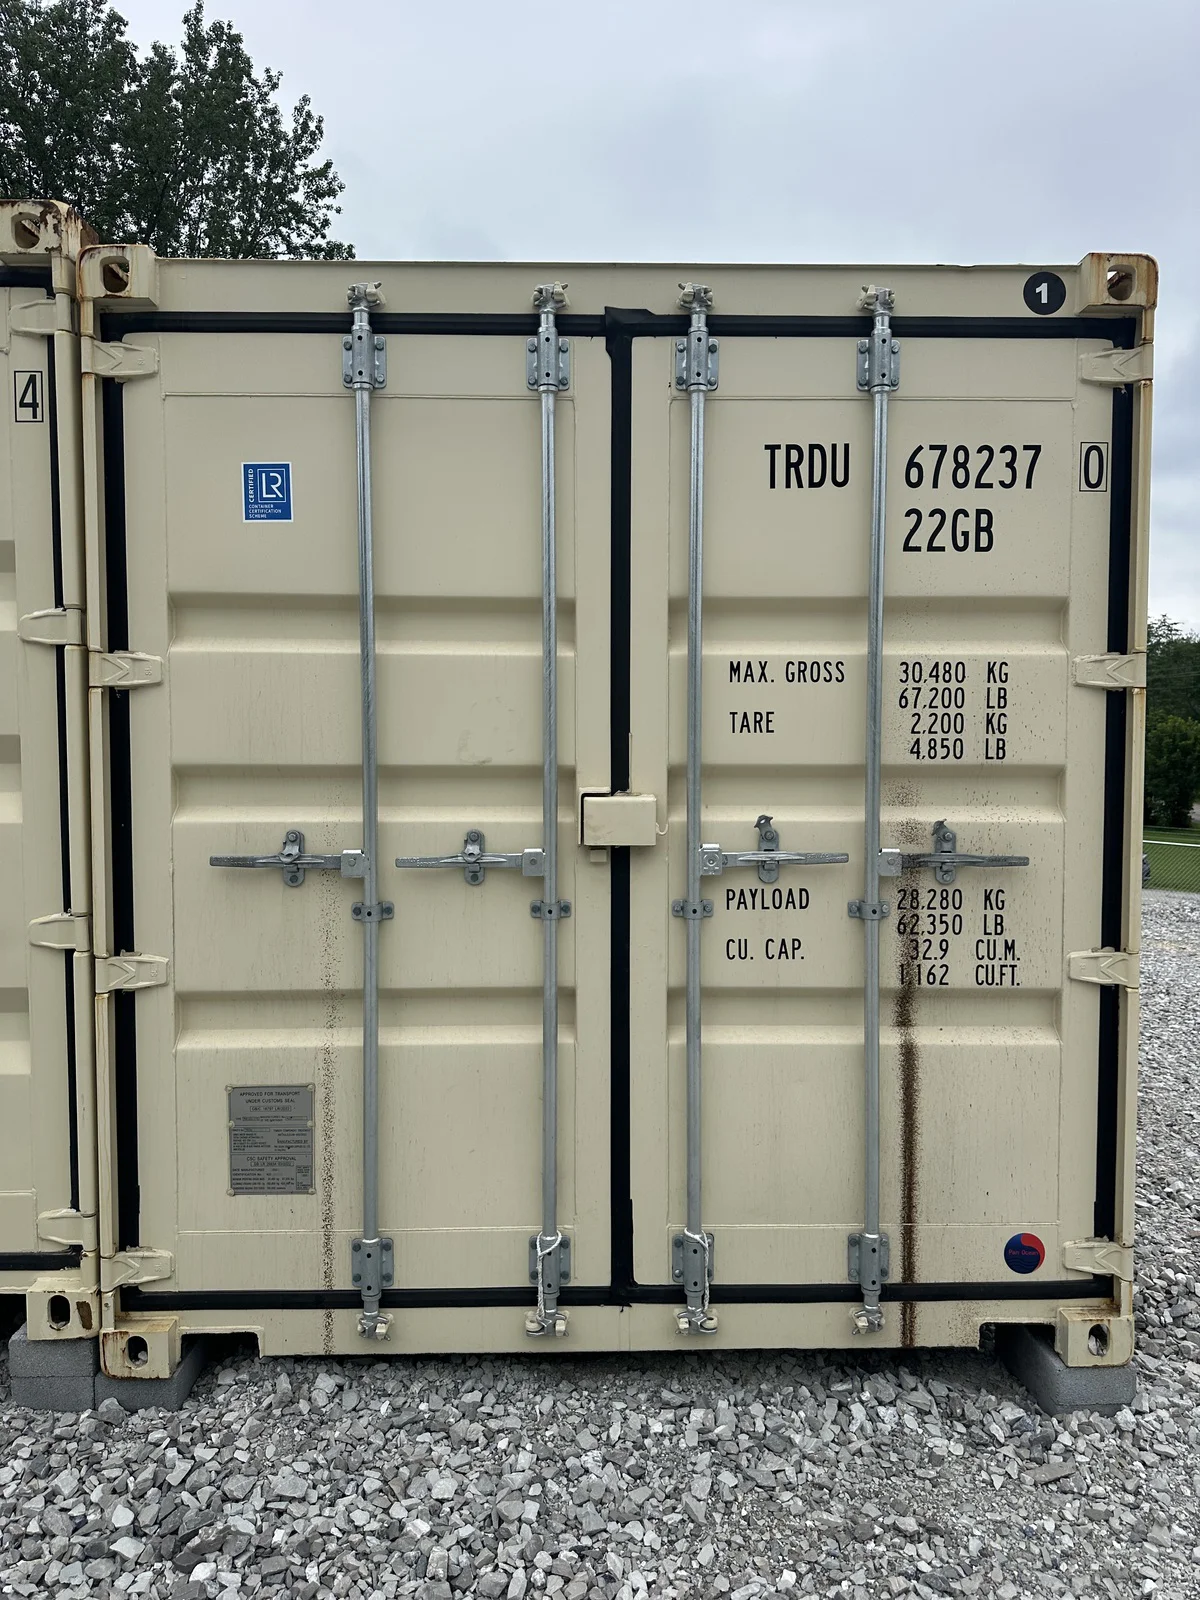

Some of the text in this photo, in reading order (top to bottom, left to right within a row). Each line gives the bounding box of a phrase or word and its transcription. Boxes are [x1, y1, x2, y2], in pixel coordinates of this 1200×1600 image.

[1035, 282, 1048, 304] 1
[18, 373, 40, 420] 4
[764, 442, 1104, 490] TRDU 678237 0
[262, 472, 284, 498] LR
[902, 507, 994, 553] 22GB
[729, 660, 1009, 685] MAX. GROSS 30,480 KG
[898, 686, 1008, 711] 67,200 LB
[729, 711, 1008, 736] TARE 2,200 KG
[909, 737, 1006, 761] 4,850 LB
[726, 887, 1006, 911] PAYLOAD 28,280 KG
[897, 913, 1005, 936] 62,350 LB
[726, 938, 1020, 962] CU. CAP. 32.9 CU.M.
[899, 963, 1020, 987] 1162 CU.FT.
